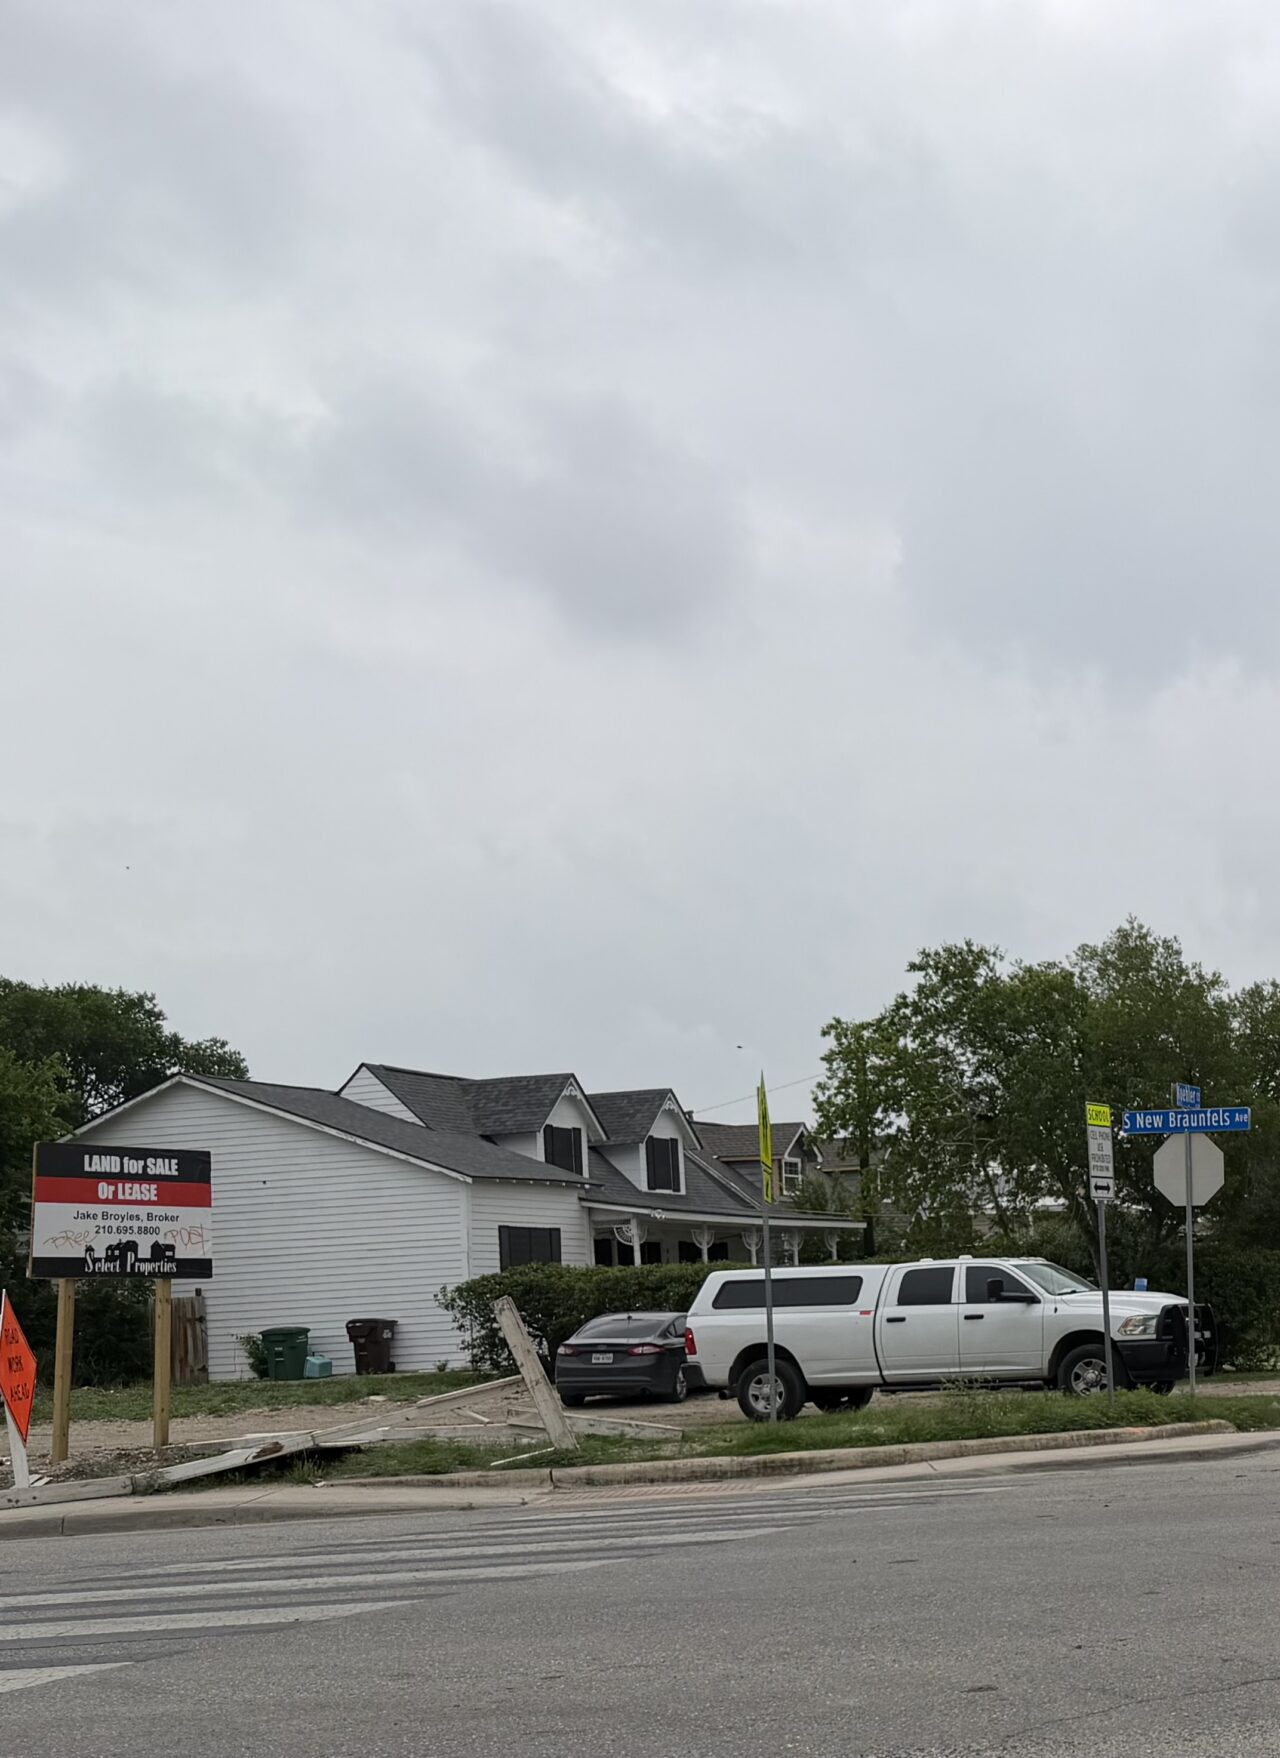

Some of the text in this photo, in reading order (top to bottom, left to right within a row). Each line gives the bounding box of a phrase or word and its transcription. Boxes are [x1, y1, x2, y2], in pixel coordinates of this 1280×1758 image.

[1088, 1108, 1110, 1122] SCHOOL
[1123, 1110, 1248, 1129] S New Braunfels Ave
[84, 1154, 179, 1176] LAND for SALE
[97, 1182, 158, 1201] Or LEASE
[73, 1210, 180, 1223] Jake Broyles, Broker
[95, 1224, 161, 1236] 210.695.8800
[85, 1250, 177, 1276] Select Properties
[7, 1355, 24, 1373] WORK
[10, 1382, 30, 1402] AHEAD
